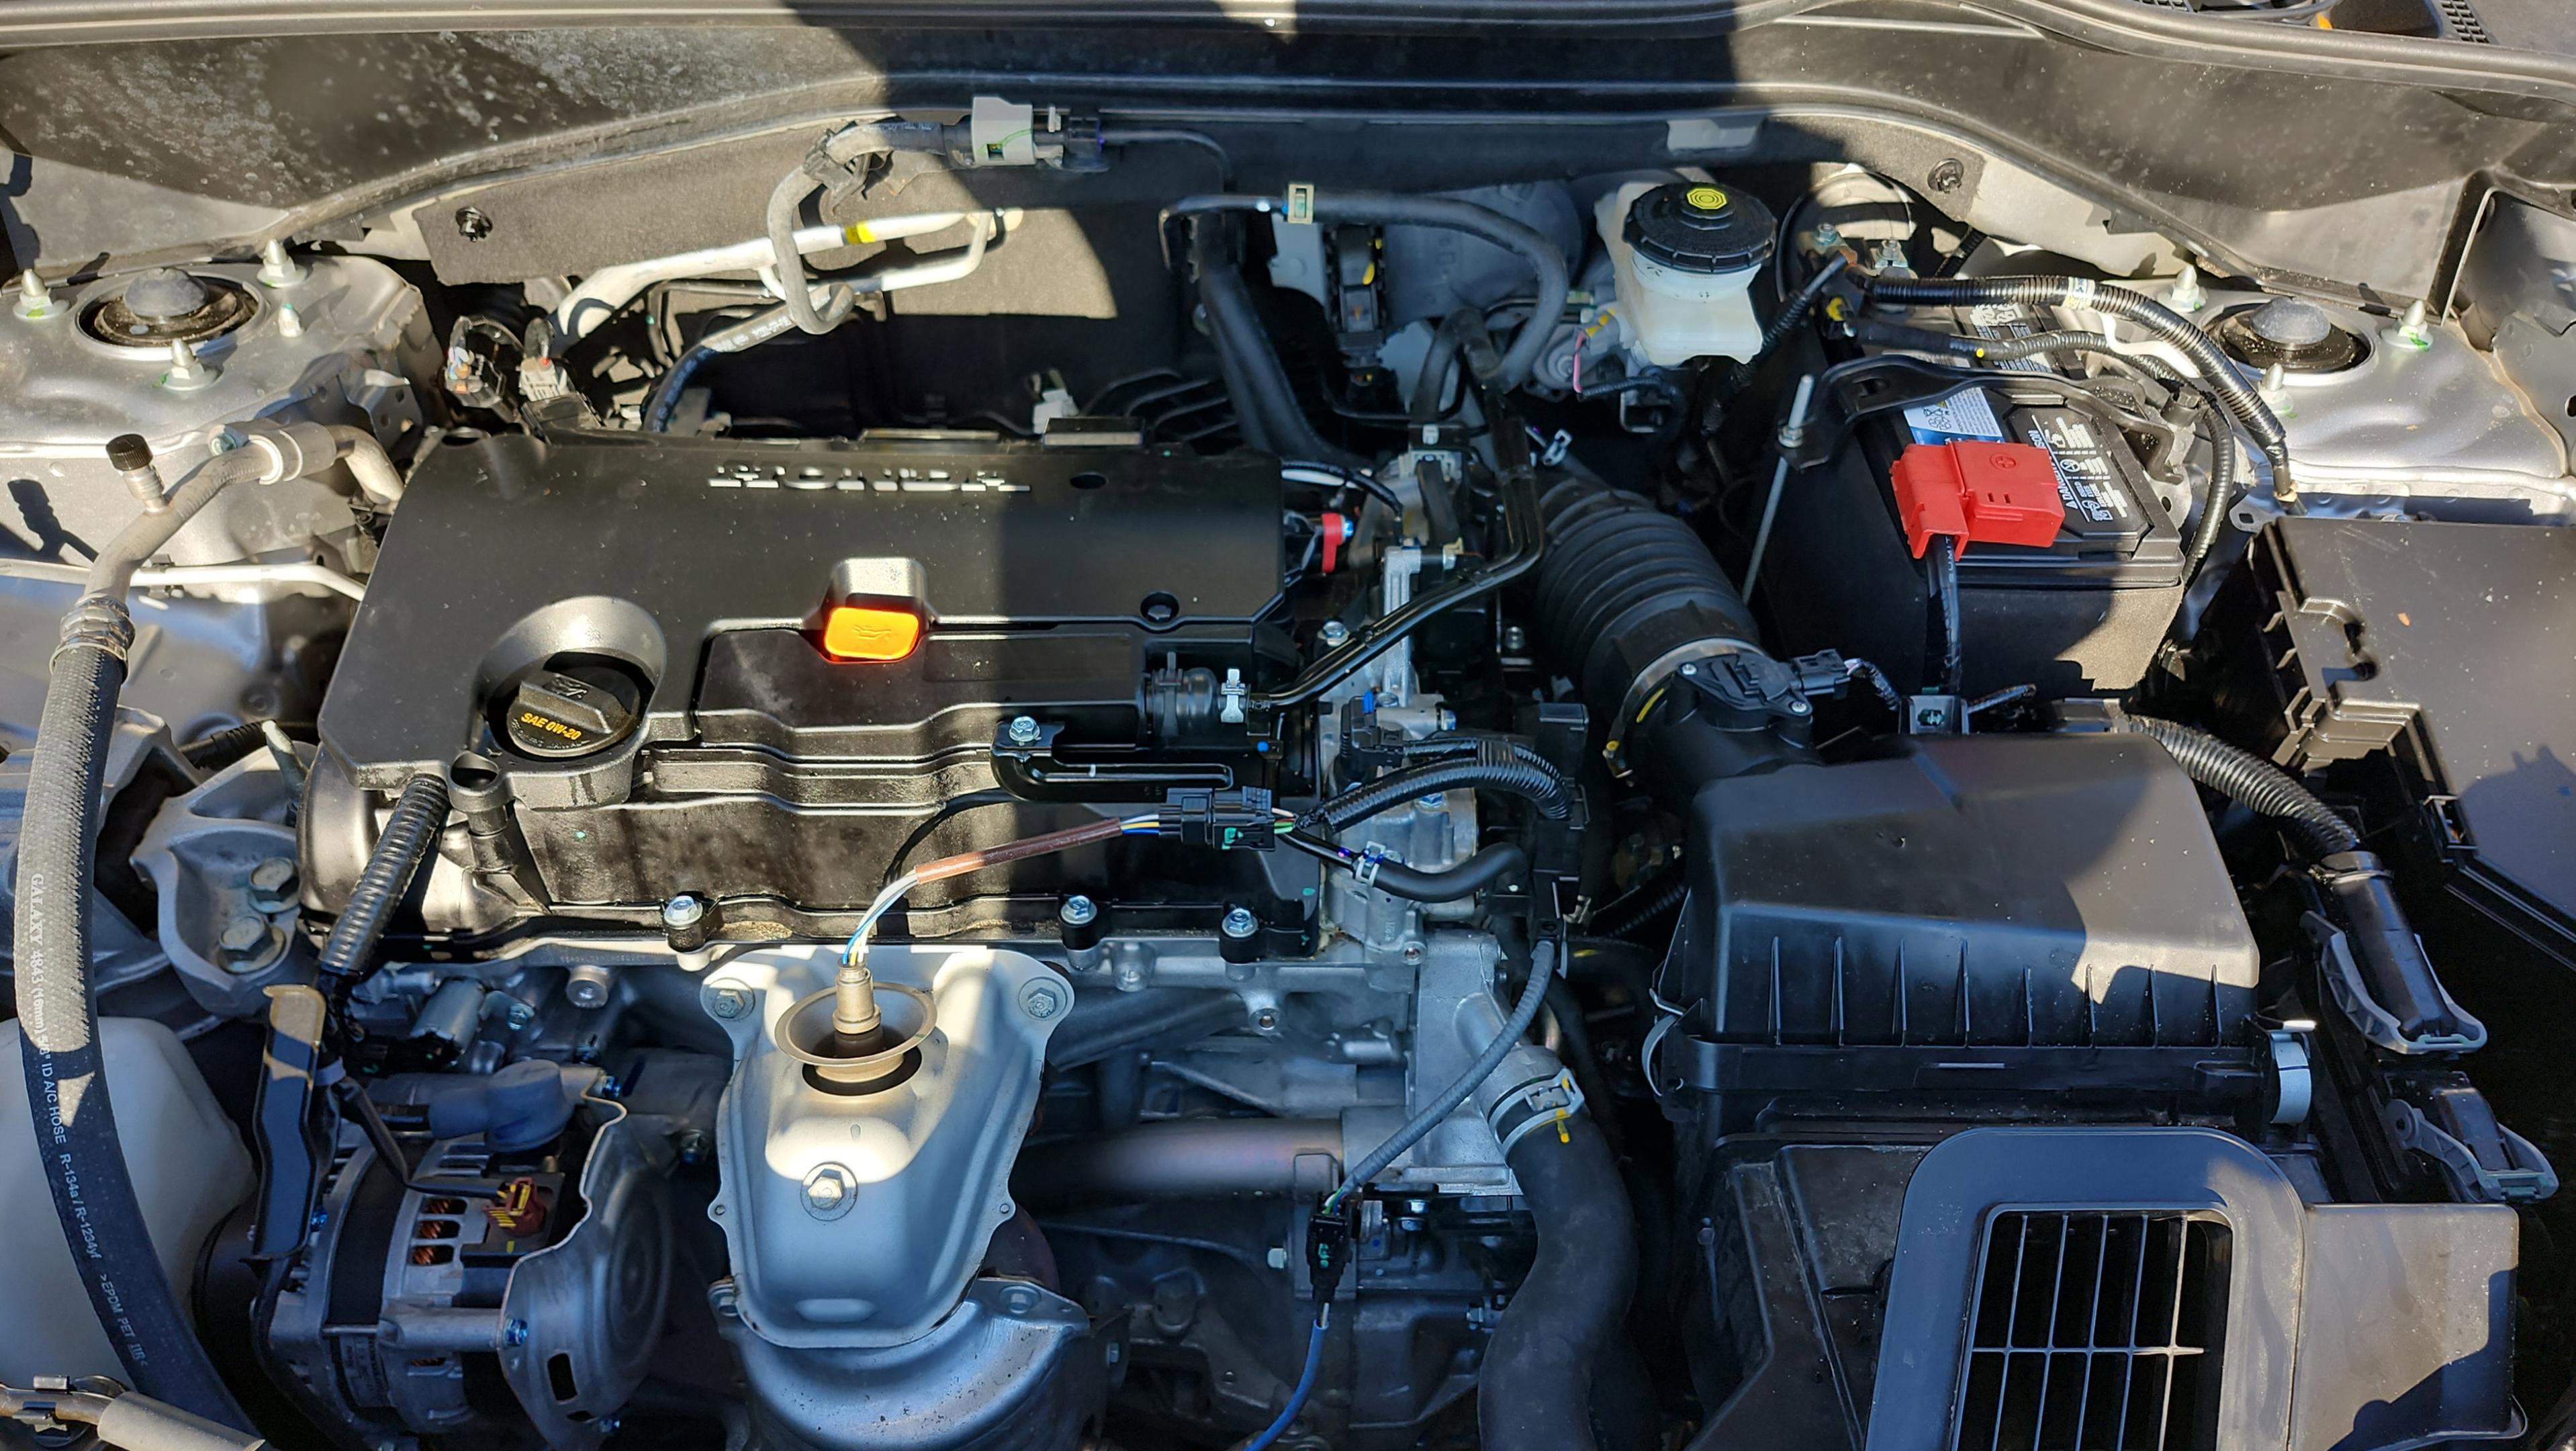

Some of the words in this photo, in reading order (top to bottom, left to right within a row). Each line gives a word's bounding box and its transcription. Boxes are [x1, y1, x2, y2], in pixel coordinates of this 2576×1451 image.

[520, 713, 549, 728] SAE
[545, 722, 582, 740] 0W-20
[30, 873, 44, 947] GALAXY
[30, 949, 44, 984] 4843
[30, 987, 47, 1035] (16mm)
[42, 1063, 54, 1077] ID
[44, 1080, 58, 1103] A/C
[48, 1106, 67, 1145] HOSE
[60, 1153, 79, 1198] R-134a
[75, 1206, 102, 1260] R-1234yf
[118, 1317, 136, 1337] PET
